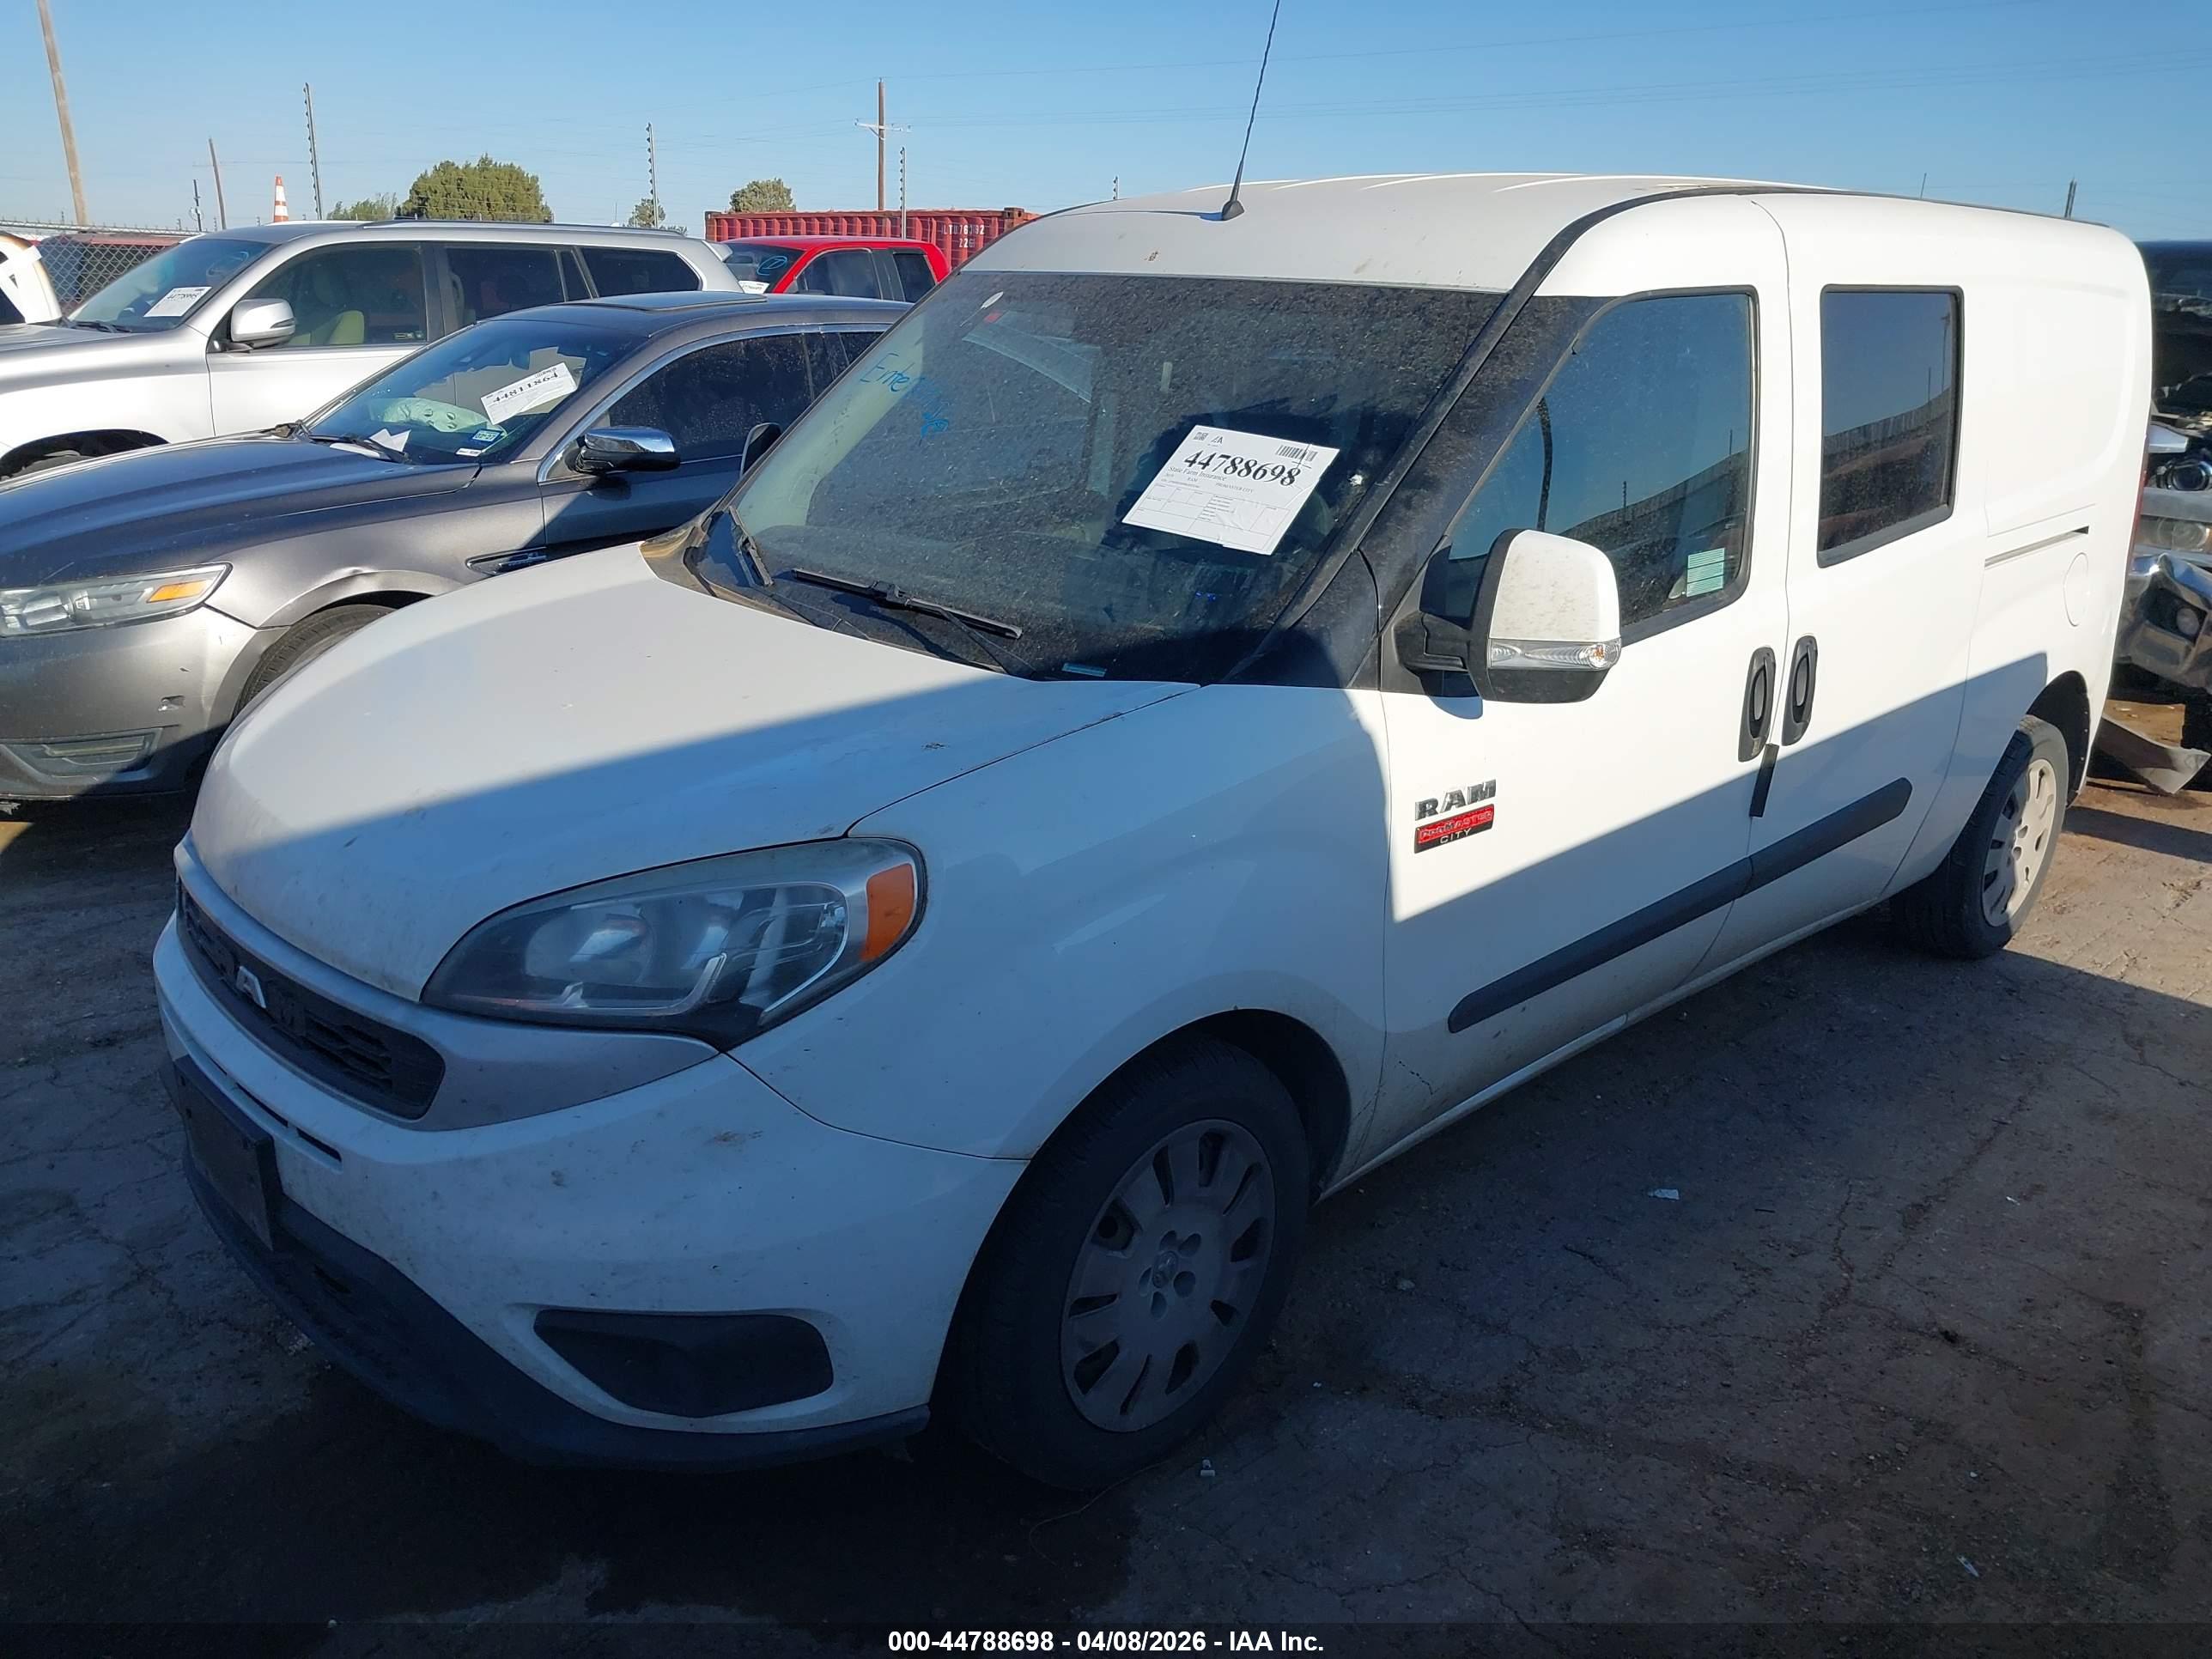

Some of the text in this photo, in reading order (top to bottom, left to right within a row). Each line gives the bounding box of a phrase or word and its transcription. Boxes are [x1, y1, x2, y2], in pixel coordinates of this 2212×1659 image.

[492, 372, 558, 402] 44811864
[1182, 468, 1199, 477] Farm
[1199, 471, 1228, 482] Insurance
[1184, 449, 1302, 487] 44788698
[1414, 778, 1497, 822] RAM
[1439, 827, 1473, 844] CITY
